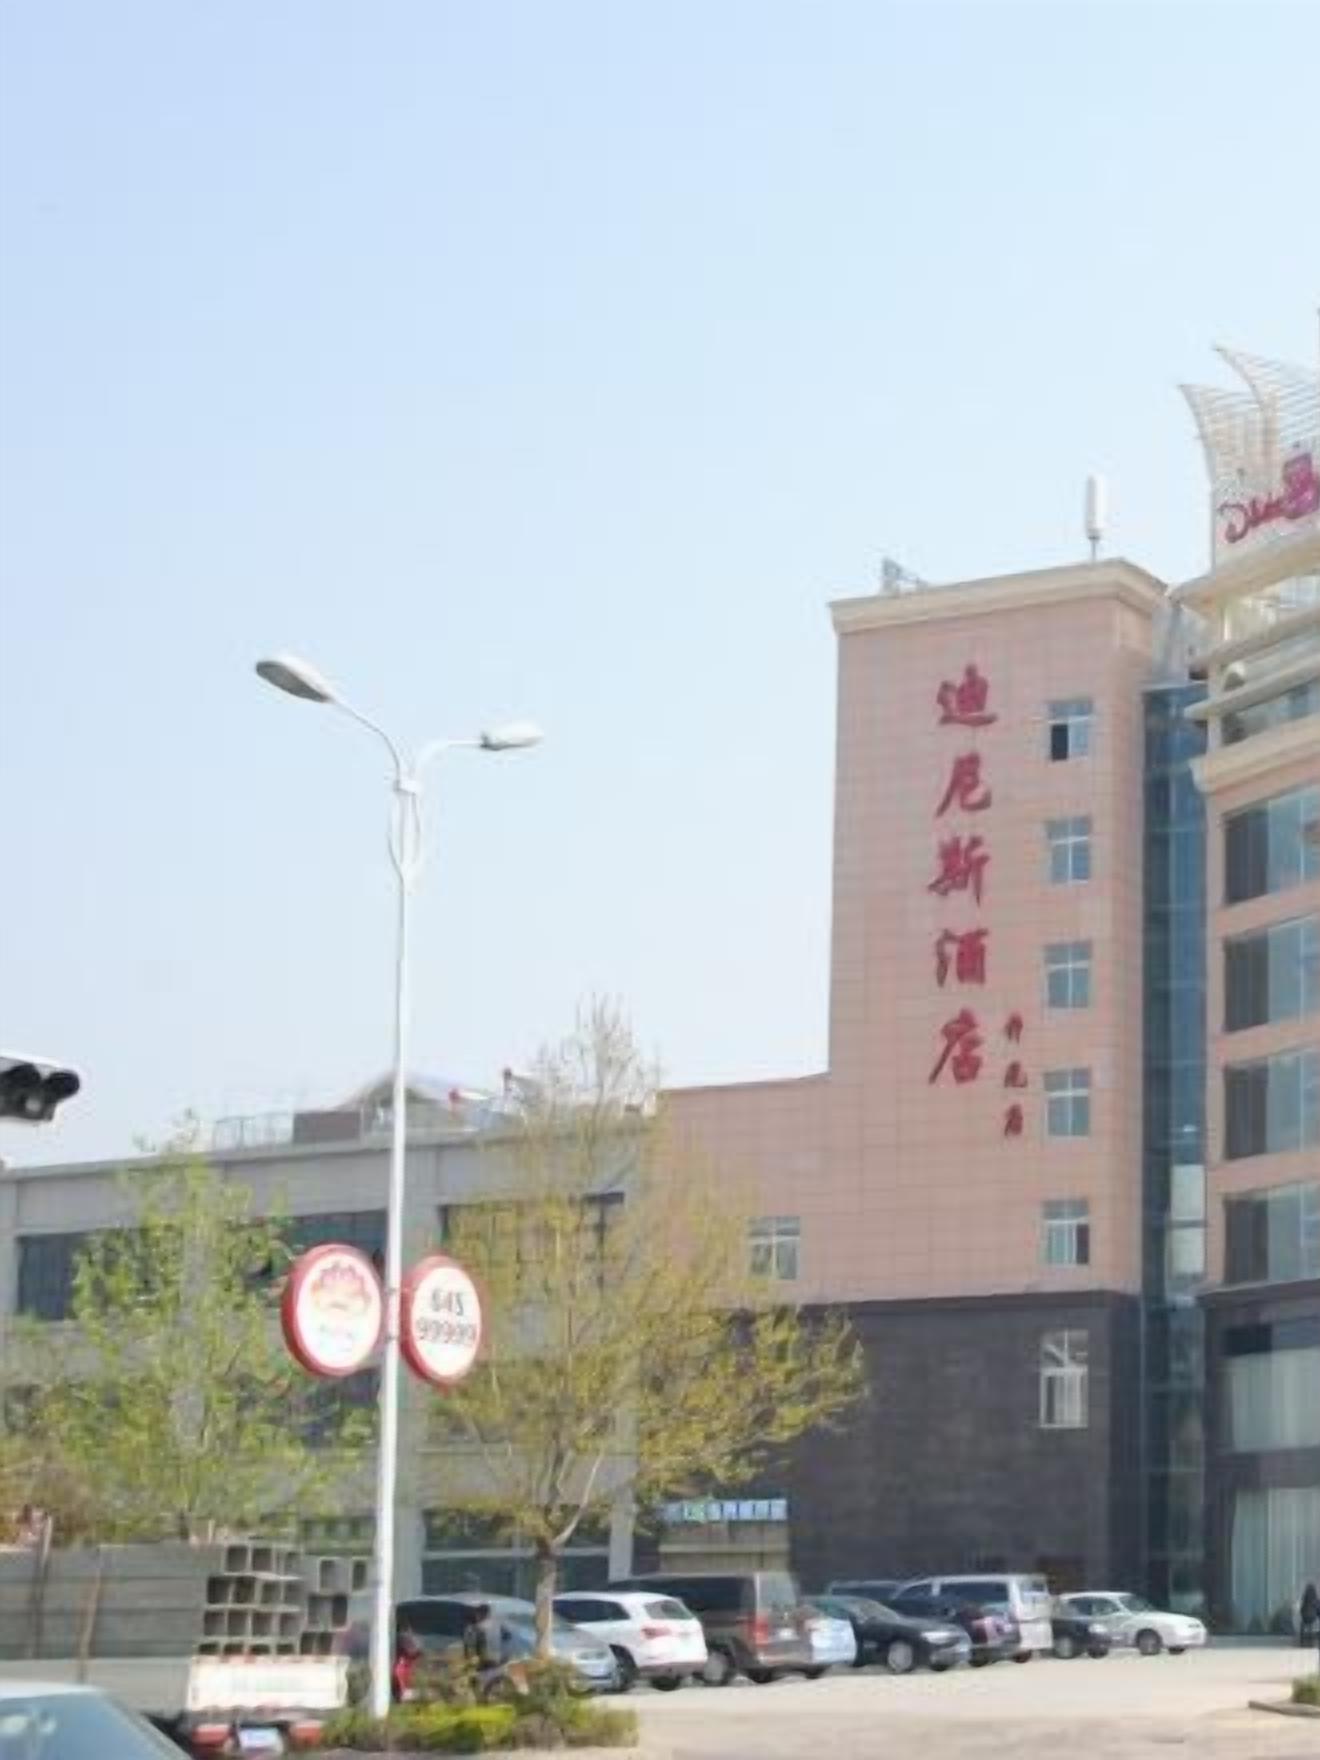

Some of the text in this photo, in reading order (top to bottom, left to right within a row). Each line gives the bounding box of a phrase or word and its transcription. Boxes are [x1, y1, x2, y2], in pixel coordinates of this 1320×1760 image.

[928, 664, 998, 1084] 迪尼斯酒店
